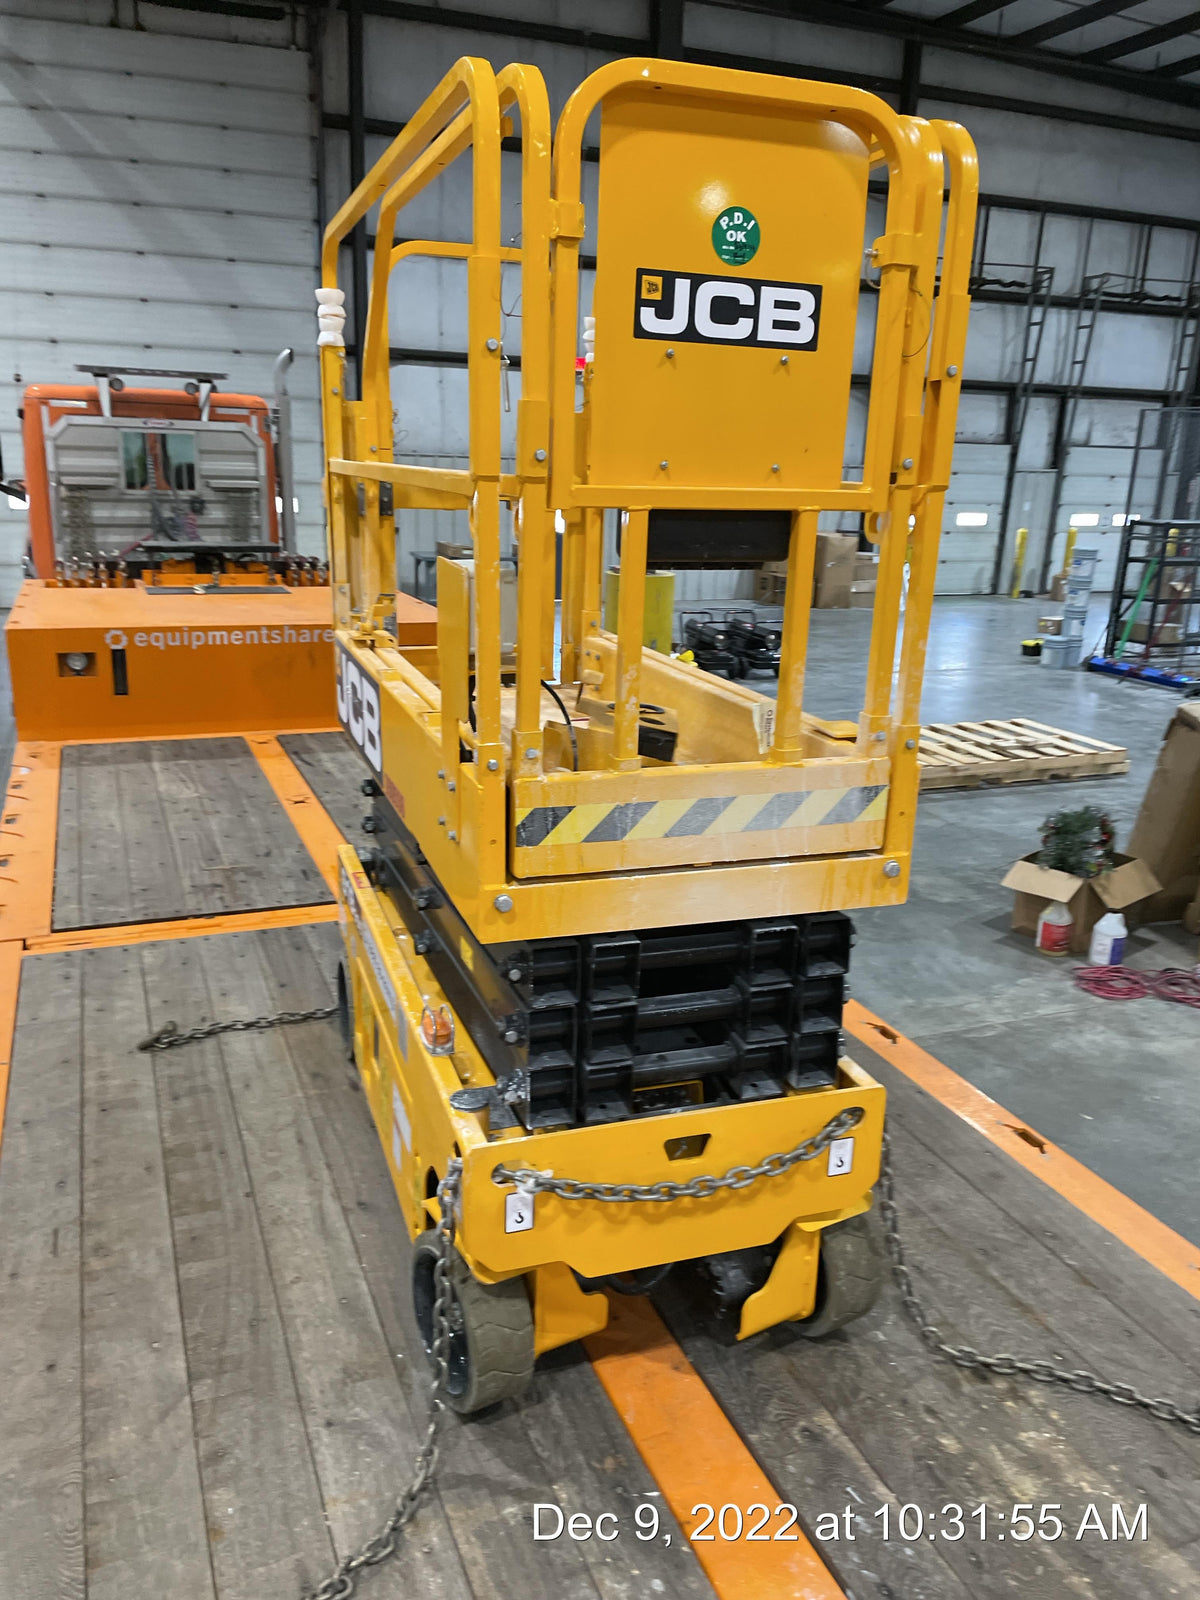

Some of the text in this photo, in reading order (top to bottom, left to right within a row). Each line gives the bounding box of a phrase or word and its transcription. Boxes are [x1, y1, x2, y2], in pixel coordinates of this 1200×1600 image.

[725, 230, 747, 243] OK
[639, 277, 816, 344] JCB
[134, 625, 335, 650] equipmentshare
[337, 652, 382, 773] JCB
